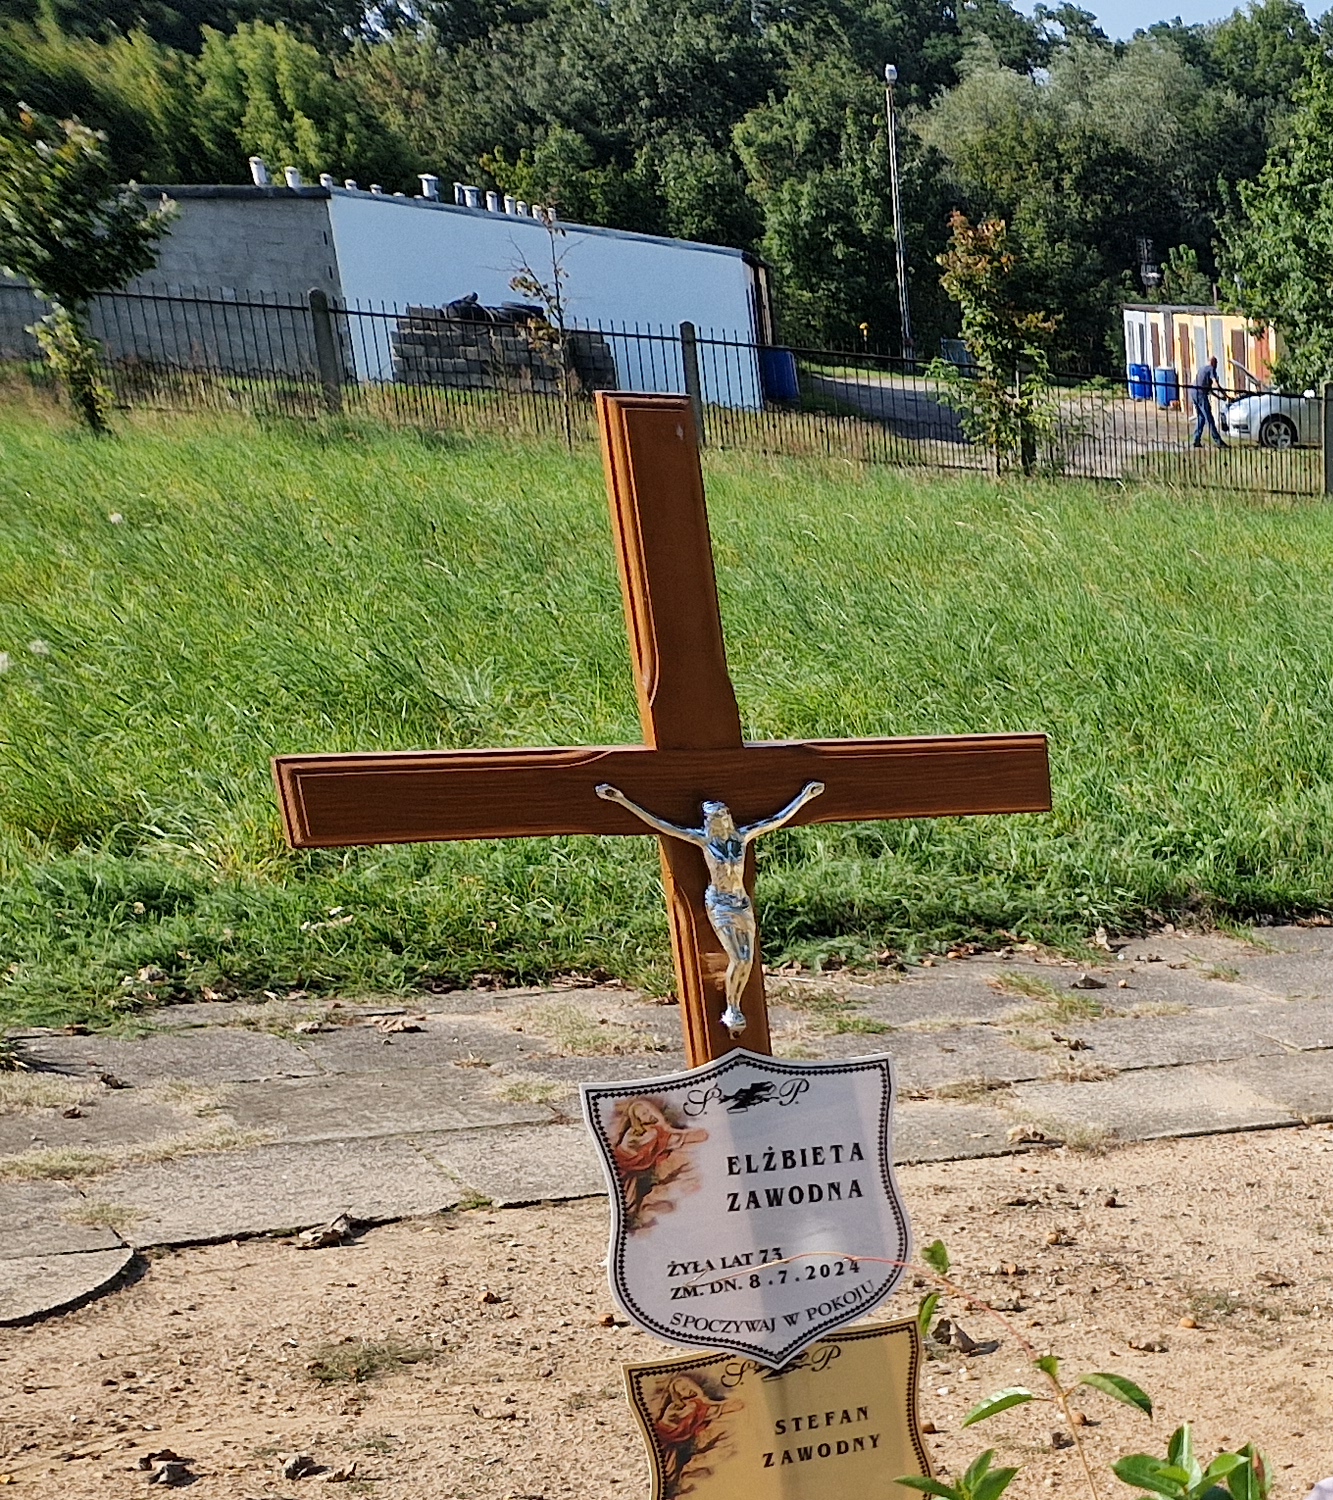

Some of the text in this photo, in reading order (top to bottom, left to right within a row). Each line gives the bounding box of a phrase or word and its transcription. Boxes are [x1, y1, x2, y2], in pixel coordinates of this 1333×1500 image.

[726, 1142, 865, 1176] ELŻBIETA
[726, 1179, 864, 1213] ZAWODNA
[667, 1246, 784, 1277] ŻYŁA LAT 73
[670, 1284, 704, 1300] ZM.
[710, 1279, 743, 1295] DN.
[669, 1280, 875, 1334] SPOCZYWAJ W POKOJU
[774, 1404, 869, 1435] STEFAN
[763, 1434, 881, 1468] ZAWODNY
